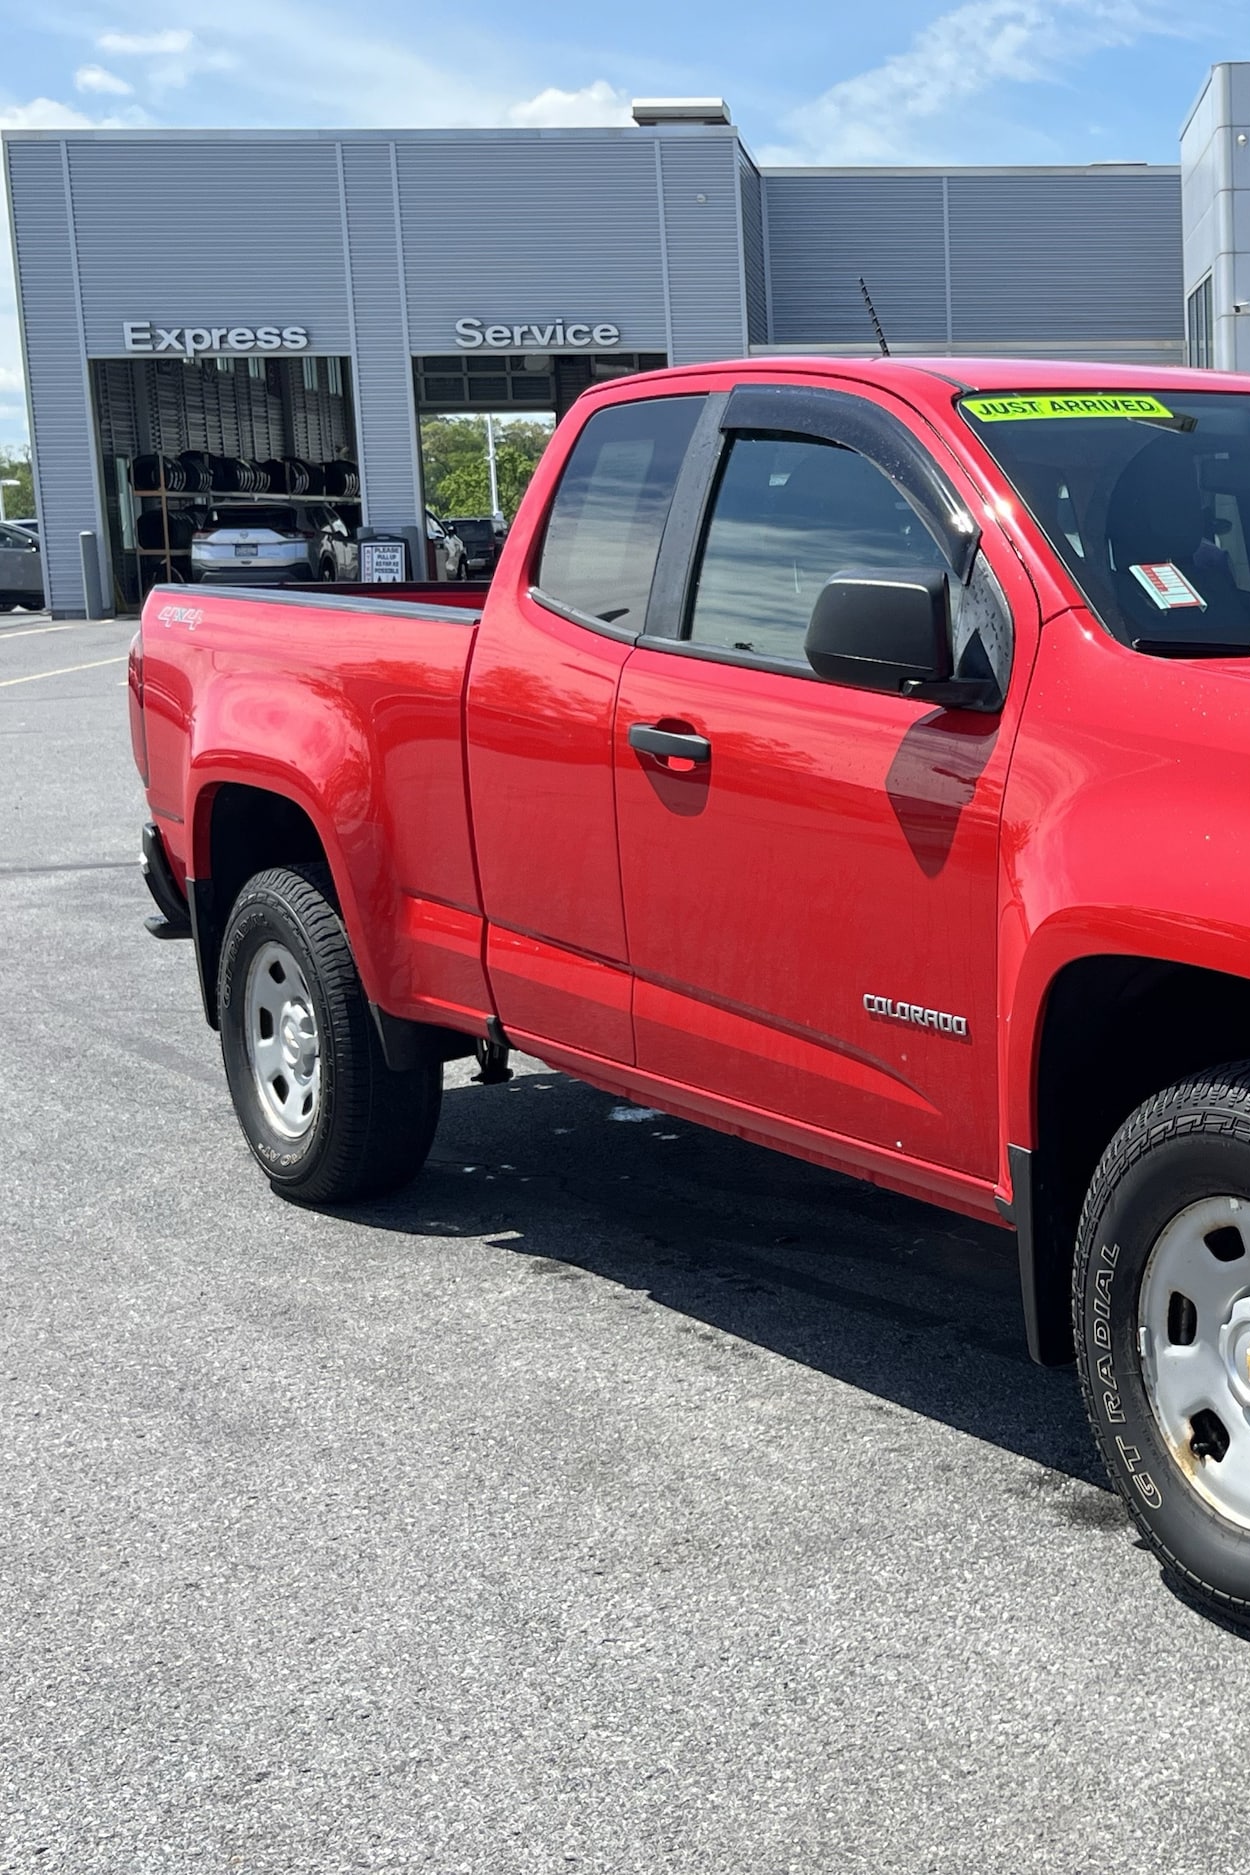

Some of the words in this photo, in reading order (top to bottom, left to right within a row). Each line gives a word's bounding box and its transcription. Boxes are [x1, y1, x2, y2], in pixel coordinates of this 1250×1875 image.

[122, 321, 308, 357] Express
[455, 317, 620, 348] Service
[979, 400, 1041, 416] JUST
[1050, 399, 1157, 414] ARRIVED
[863, 993, 967, 1035] COLORADO
[1094, 1243, 1127, 1424] RADIAL
[1114, 1434, 1163, 1510] GT
